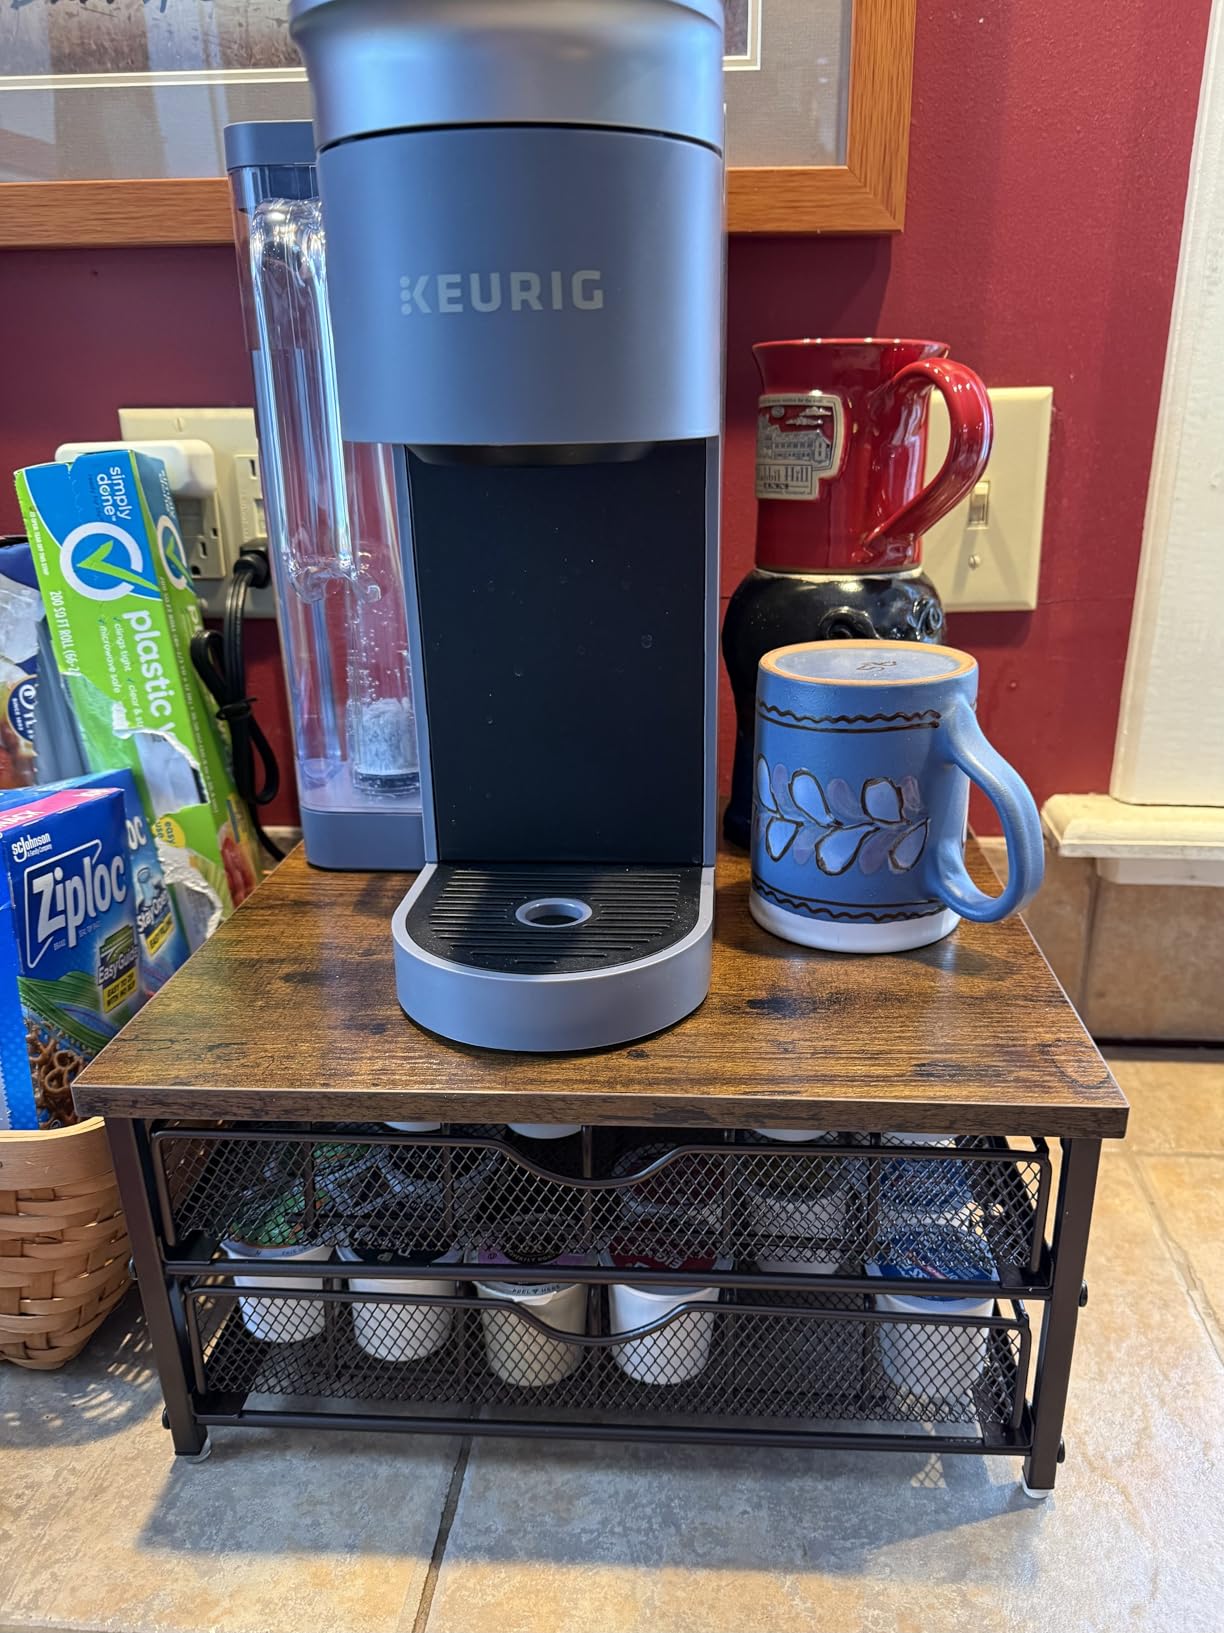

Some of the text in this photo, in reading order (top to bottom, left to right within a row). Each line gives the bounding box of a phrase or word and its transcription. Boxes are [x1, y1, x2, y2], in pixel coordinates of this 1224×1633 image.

[399, 270, 604, 315] KEURIG
[97, 474, 116, 519] done
[110, 467, 133, 520] simply
[784, 466, 809, 482] Hill
[50, 591, 65, 606] 200
[56, 619, 70, 628] FT
[58, 629, 75, 649] ROLL
[63, 649, 80, 672] (66-2
[99, 625, 122, 694] microwave safe
[114, 623, 132, 672] clings tight
[122, 610, 175, 718] plastic
[164, 821, 176, 845] easy
[32, 856, 127, 949] Ziploc
